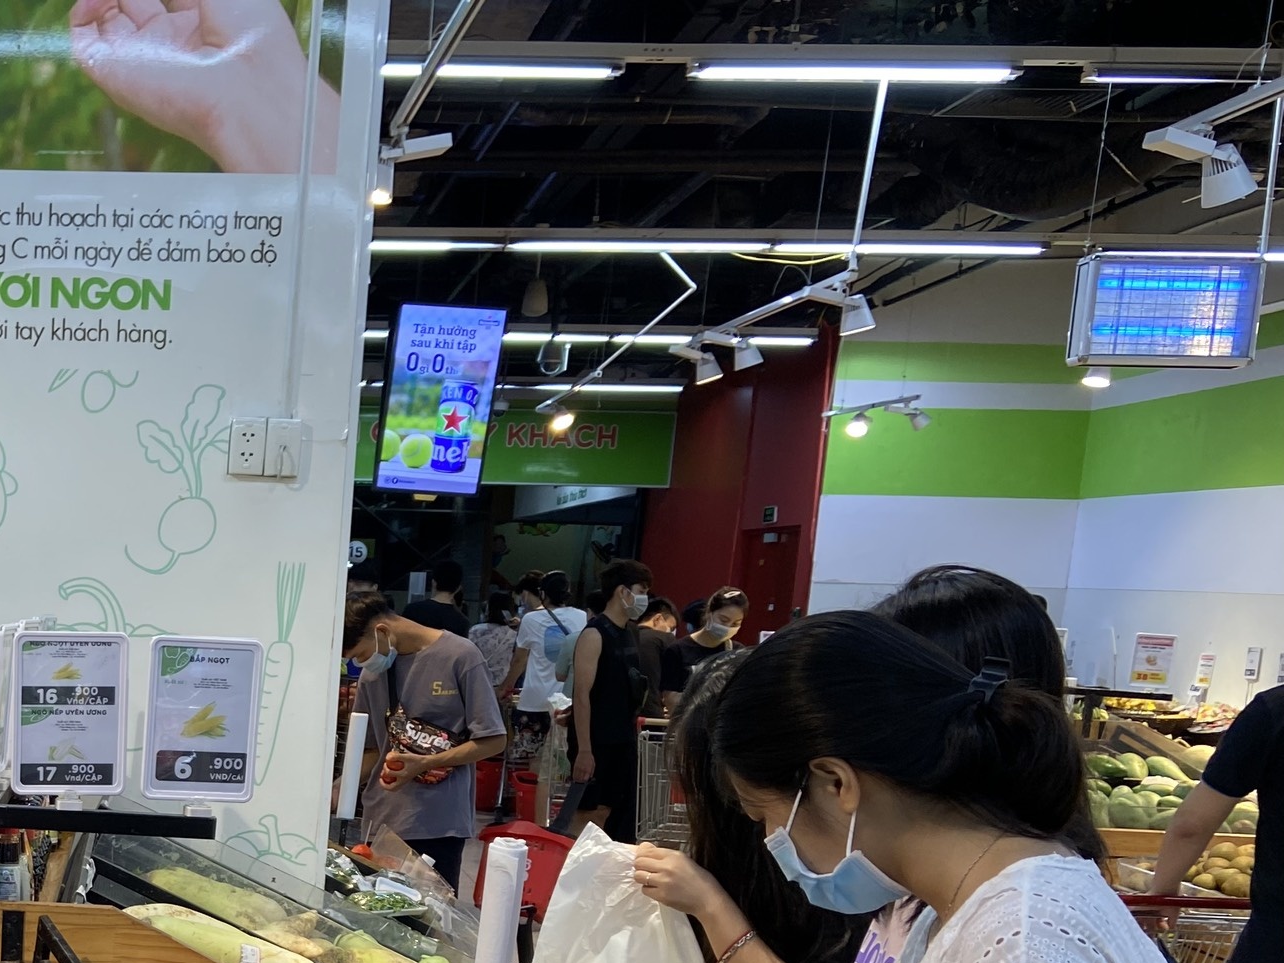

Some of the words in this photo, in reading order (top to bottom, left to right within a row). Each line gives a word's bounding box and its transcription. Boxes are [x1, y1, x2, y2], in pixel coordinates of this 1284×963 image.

[16, 202, 43, 226] thu
[48, 203, 106, 231] hoạch
[112, 207, 134, 231] tại
[139, 208, 174, 229] các
[179, 210, 228, 236] nông
[233, 211, 283, 237] trang
[11, 237, 28, 259] C
[34, 237, 68, 260] mỗi
[74, 242, 123, 267] ngày
[127, 237, 153, 262] để
[157, 238, 201, 262] đảm
[207, 239, 246, 263] bảo
[250, 240, 278, 267] độ
[50, 276, 172, 311] NGON
[15, 321, 45, 347] tay
[51, 317, 109, 342] khách
[116, 319, 173, 350] hàng.
[413, 323, 435, 337] Tận
[437, 325, 477, 340] hưởng
[410, 339, 432, 348] sau
[434, 338, 454, 350] khi
[457, 340, 477, 353] tập
[36, 688, 58, 704] 16
[36, 766, 58, 782] 17
[174, 755, 193, 780] 6
